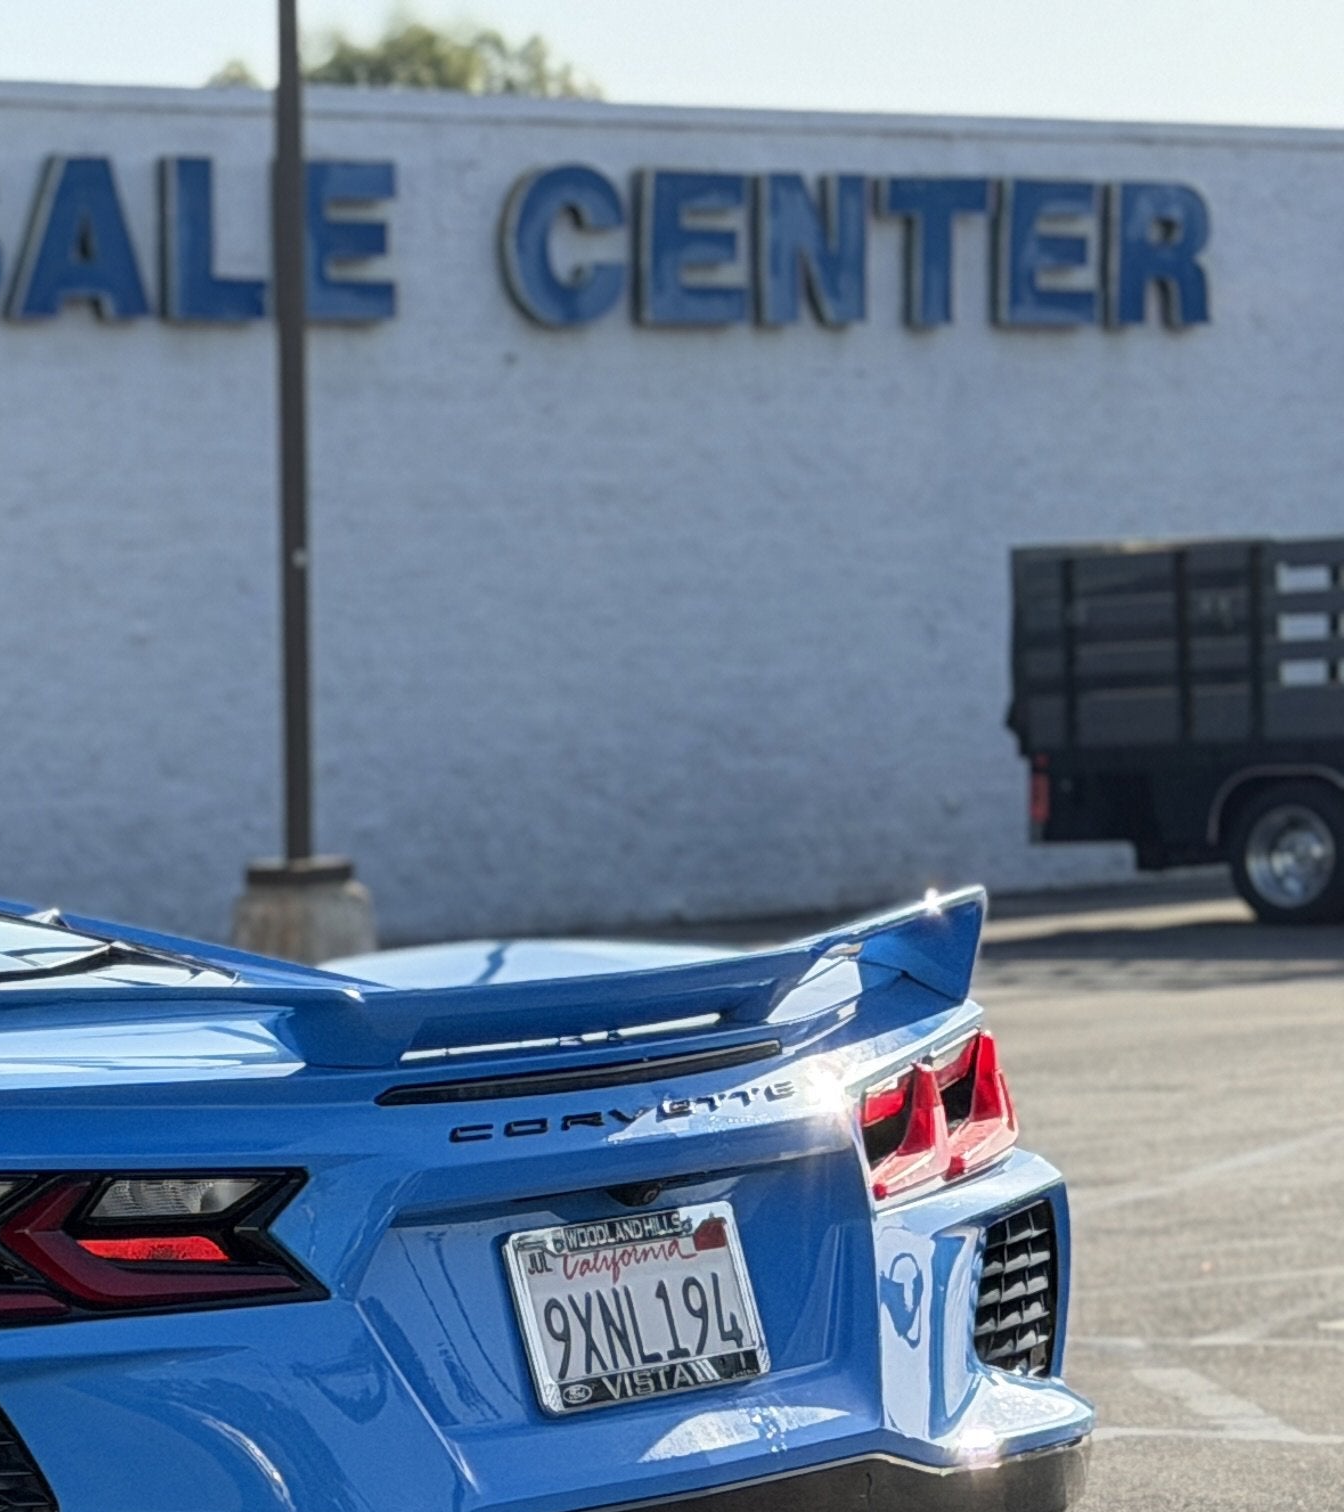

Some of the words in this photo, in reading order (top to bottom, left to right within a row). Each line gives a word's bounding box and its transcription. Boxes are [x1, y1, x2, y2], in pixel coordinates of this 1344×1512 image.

[498, 160, 1213, 330] CENTER
[449, 1080, 797, 1143] CORVETTE
[526, 1251, 554, 1276] JUL
[563, 1239, 697, 1283] California
[545, 1273, 743, 1379] 9XNL194
[600, 1360, 701, 1401] VISTA
